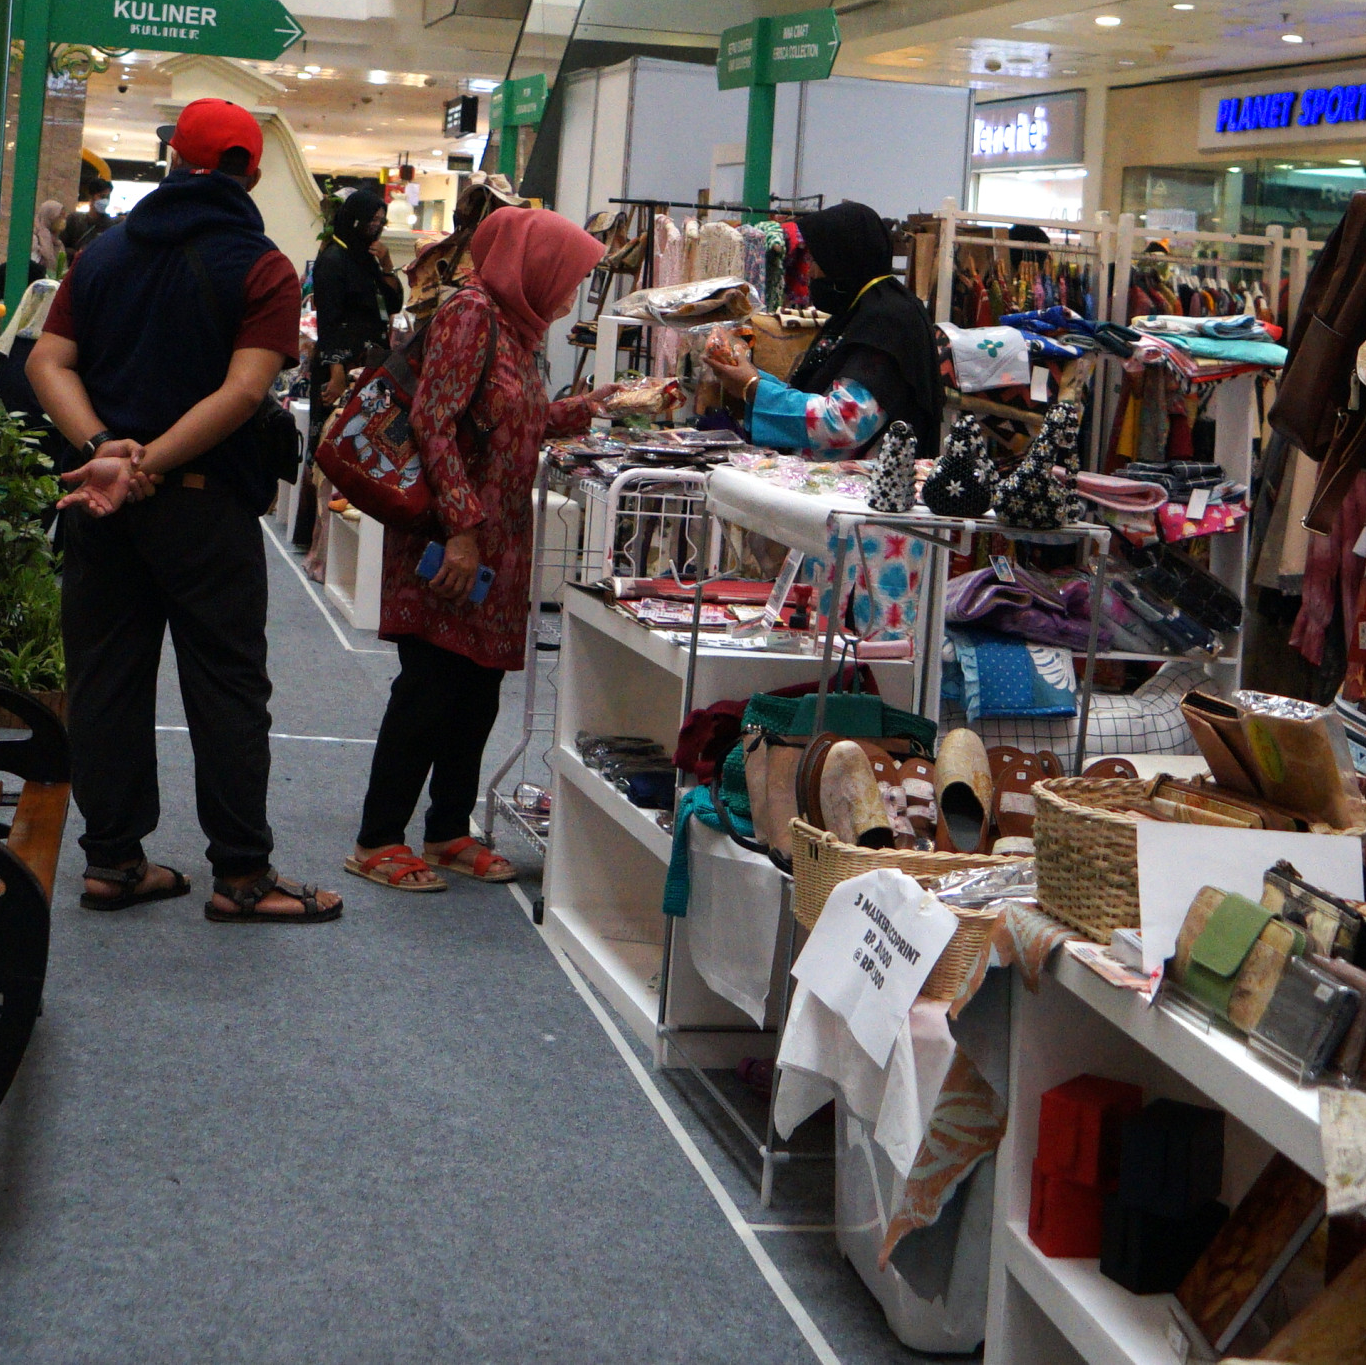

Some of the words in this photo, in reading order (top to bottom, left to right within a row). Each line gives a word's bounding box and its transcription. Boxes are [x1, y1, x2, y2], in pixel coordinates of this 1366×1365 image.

[113, 0, 217, 27] KULINER
[130, 24, 200, 40] KULINER
[1215, 92, 1297, 133] PLANET
[854, 893, 864, 906] 3
[861, 898, 890, 935] MASKER
